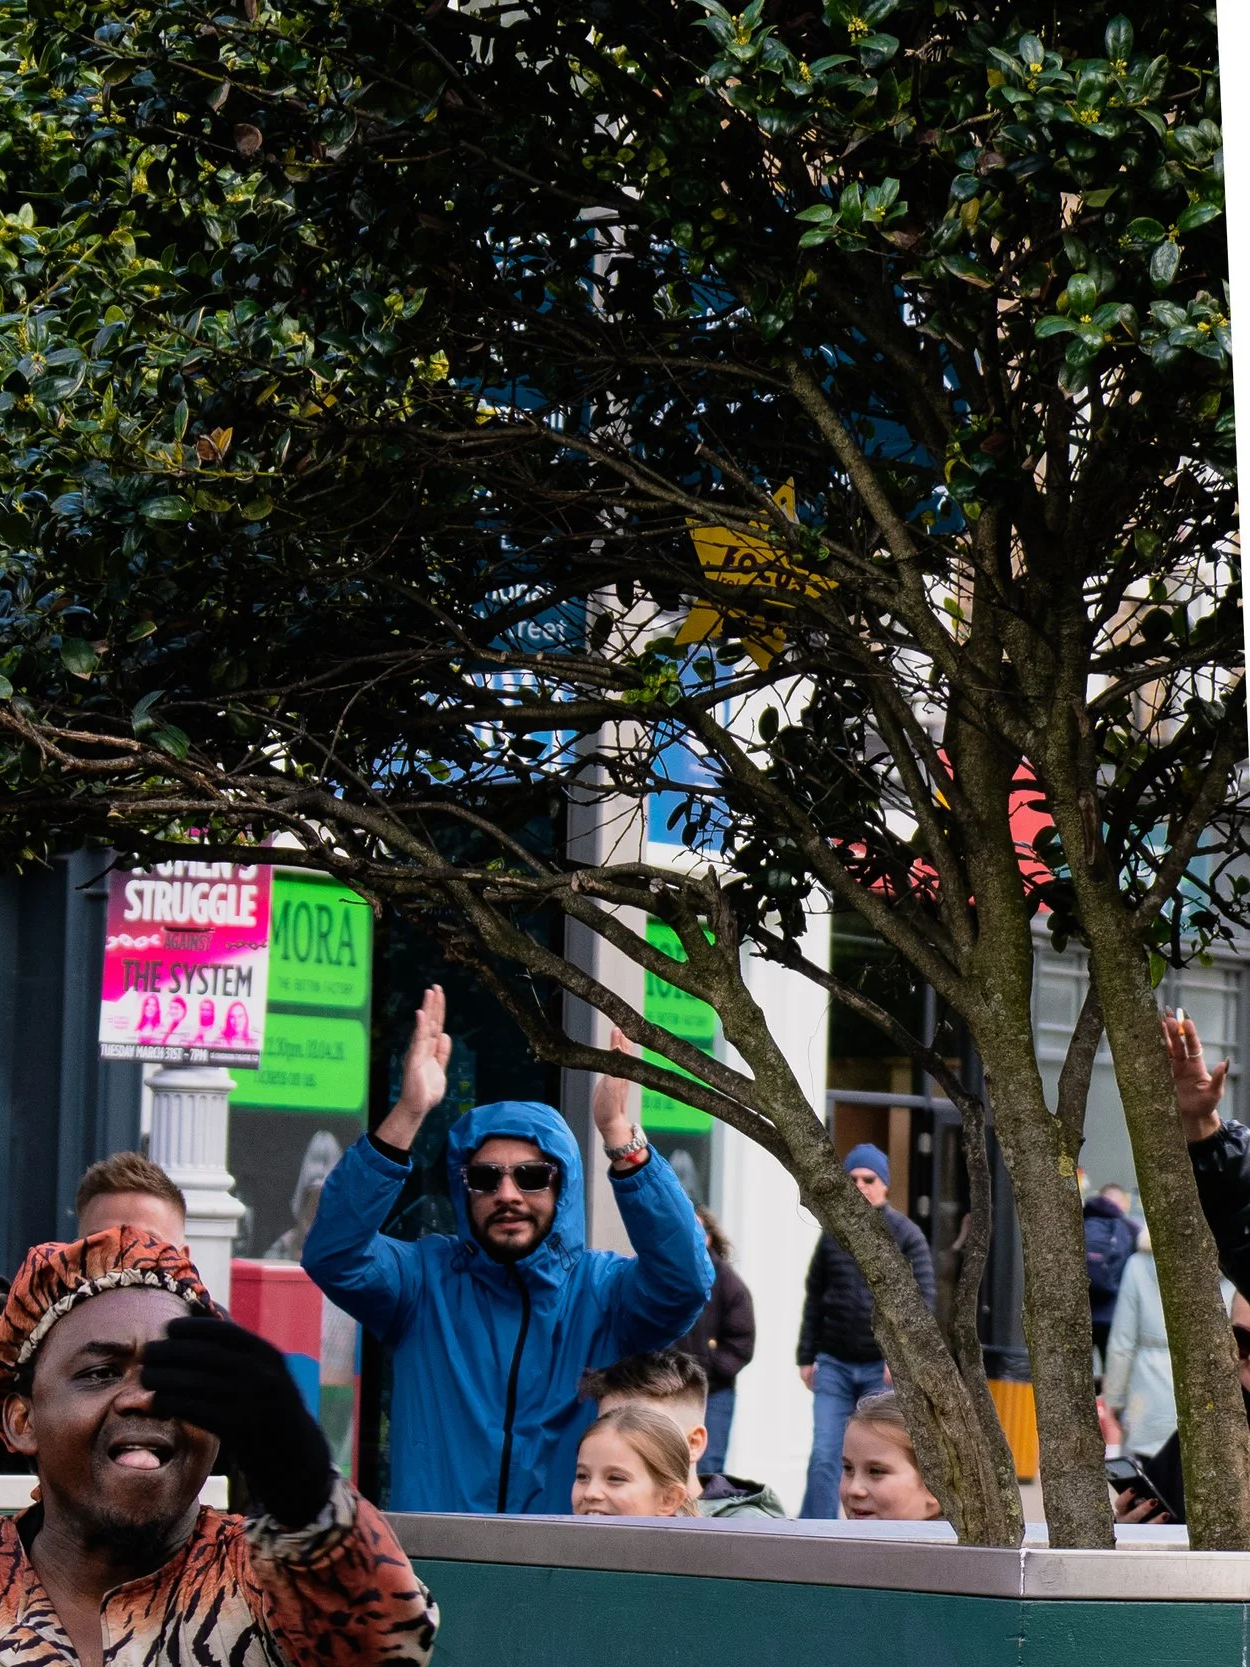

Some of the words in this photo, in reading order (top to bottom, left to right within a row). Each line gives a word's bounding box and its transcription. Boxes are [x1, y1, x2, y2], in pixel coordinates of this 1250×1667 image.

[124, 880, 258, 927] STRUGGLE
[163, 931, 213, 951] AGAINST
[123, 959, 163, 993] THE
[168, 962, 253, 997] SYSTEM
[100, 1043, 134, 1058] TUESDAY
[135, 1045, 165, 1060] MARCH
[190, 1047, 209, 1063] 7PM
